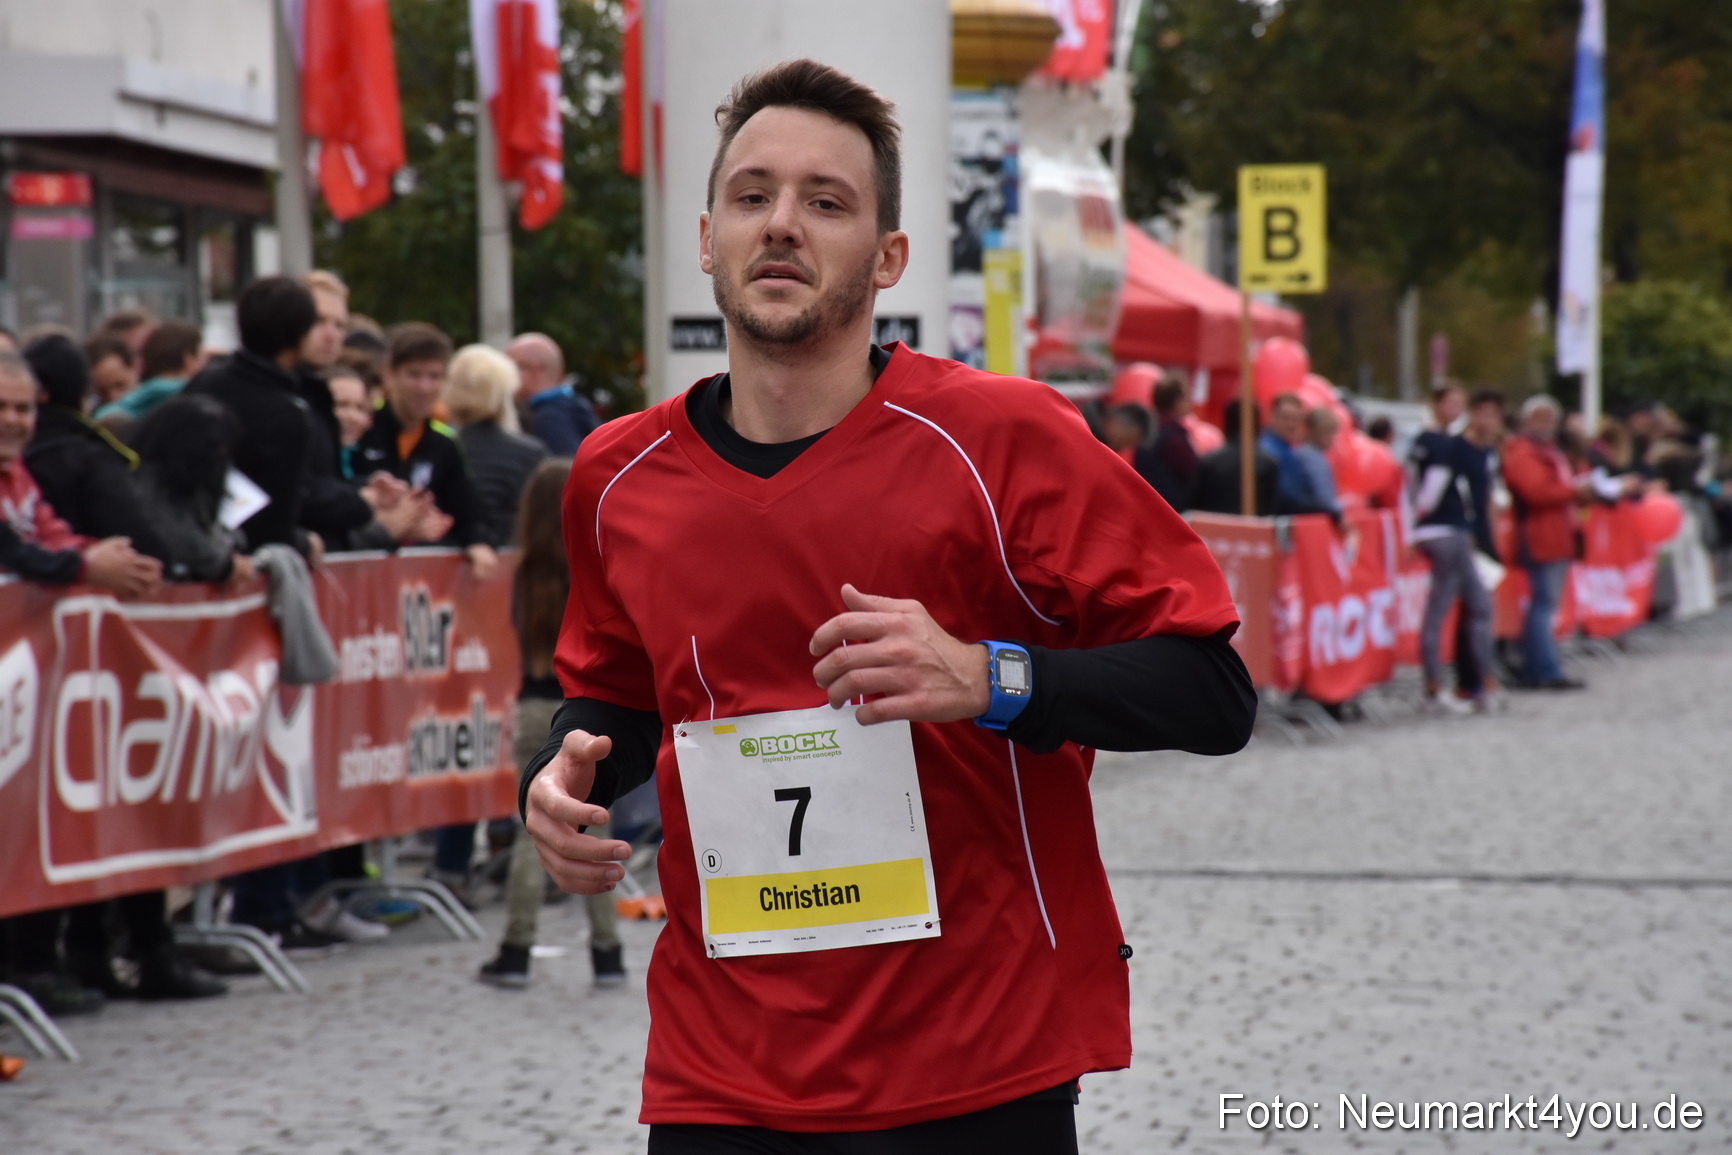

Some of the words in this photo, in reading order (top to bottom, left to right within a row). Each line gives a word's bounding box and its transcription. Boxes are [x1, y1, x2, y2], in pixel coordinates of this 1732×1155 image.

[1264, 206, 1302, 262] B
[760, 730, 840, 756] BOCK
[762, 755, 783, 763] inspired
[793, 752, 811, 760] smart
[812, 749, 842, 758] concepts
[774, 786, 812, 856] 7
[708, 855, 716, 867] D
[759, 882, 861, 912] Christian
